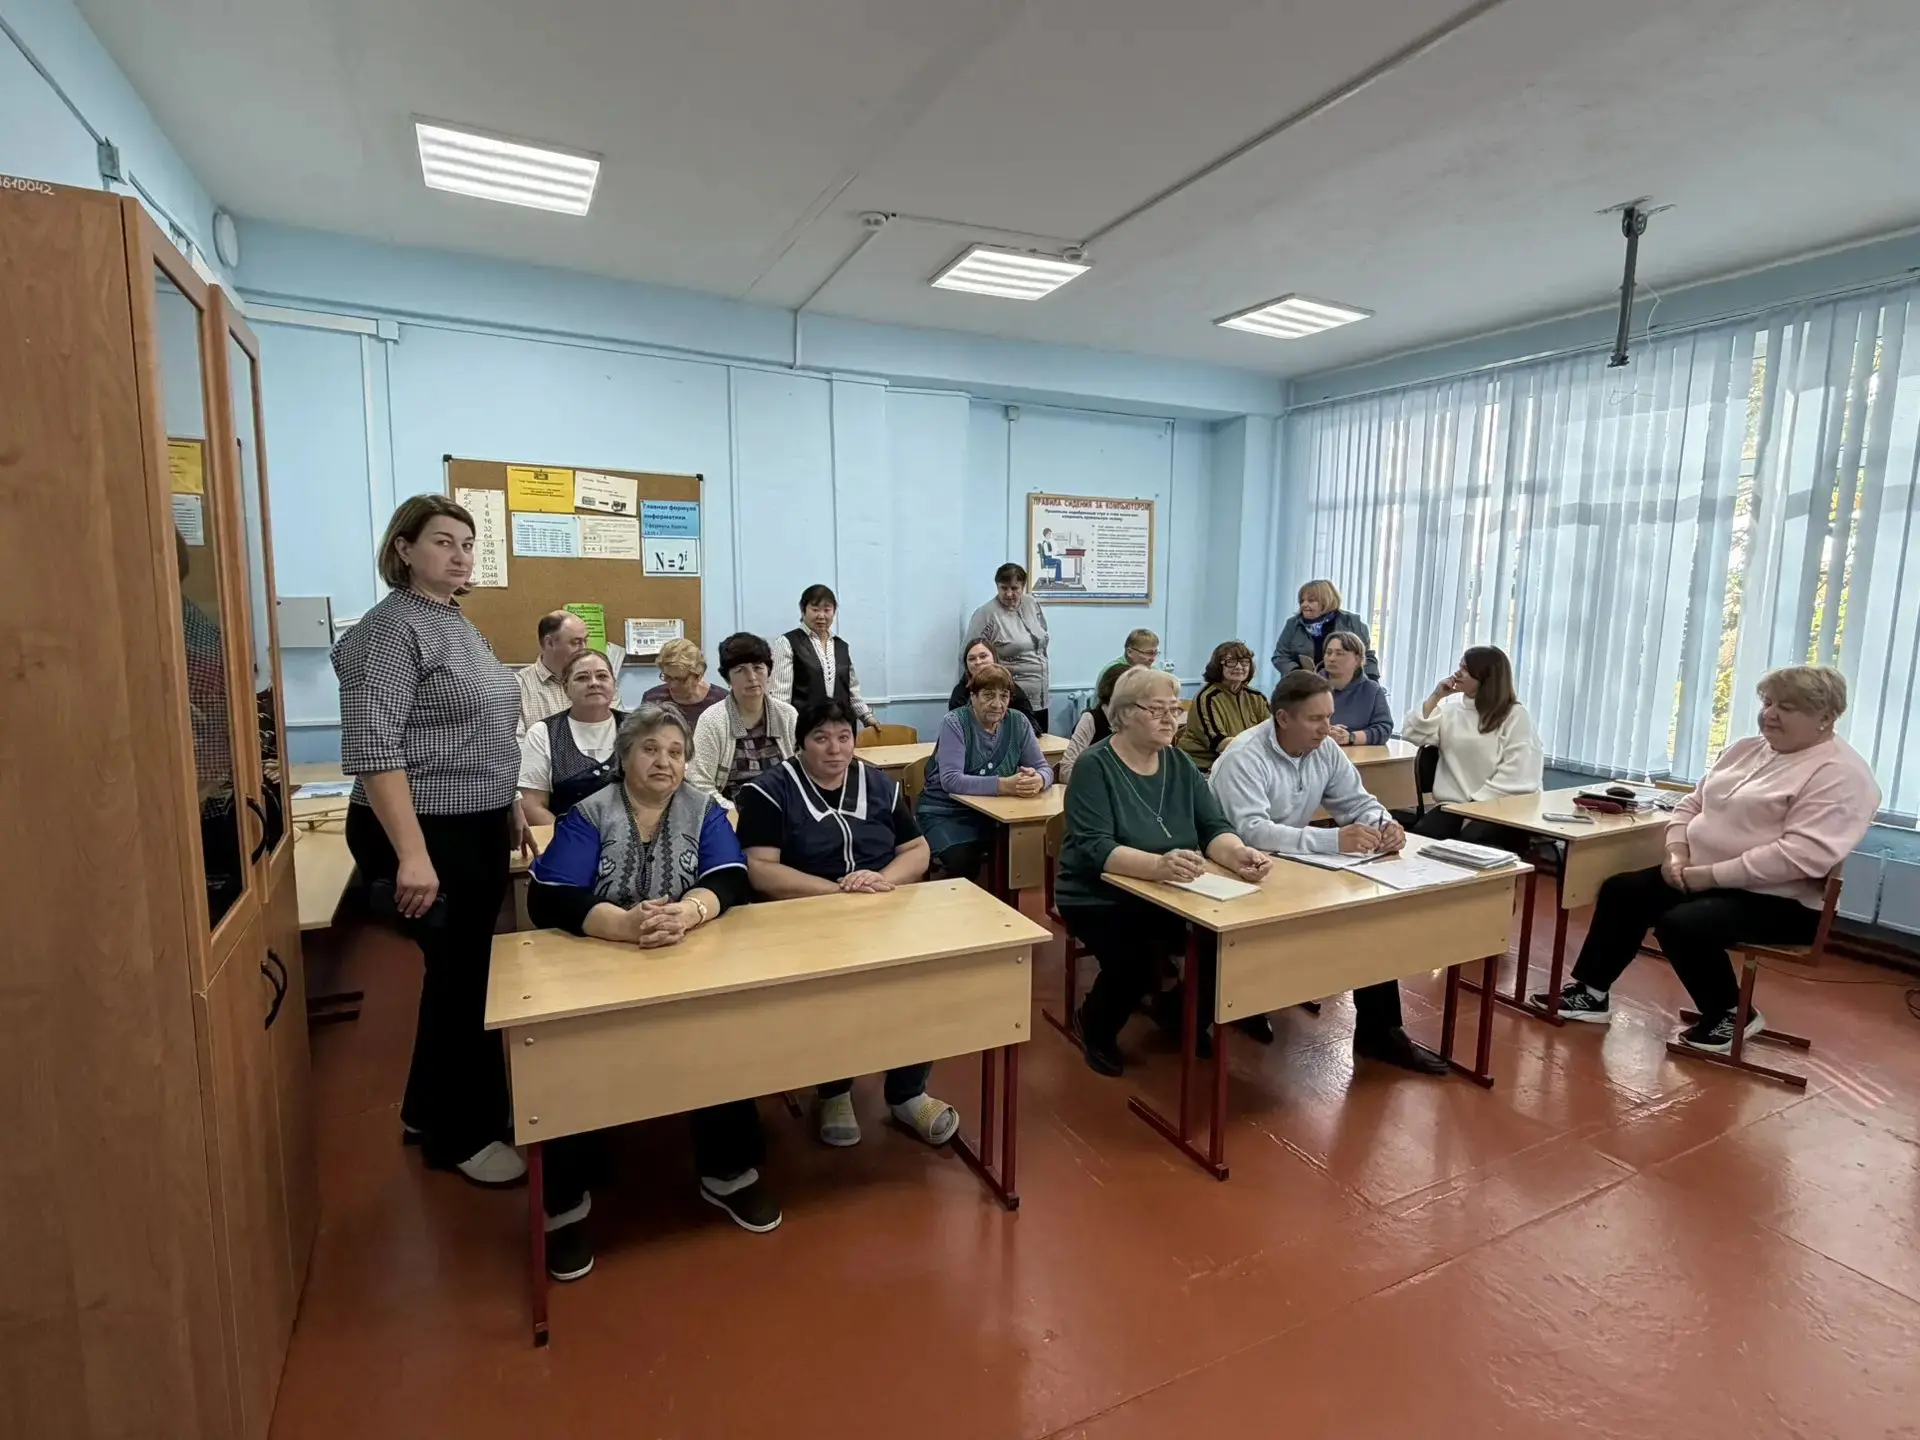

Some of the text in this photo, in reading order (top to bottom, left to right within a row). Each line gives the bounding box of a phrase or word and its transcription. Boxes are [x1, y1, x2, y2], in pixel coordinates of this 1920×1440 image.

[1034, 497, 1061, 506] ПРАВИЛА
[1064, 499, 1092, 508] СИДЕНИЯ
[655, 551, 665, 571] N
